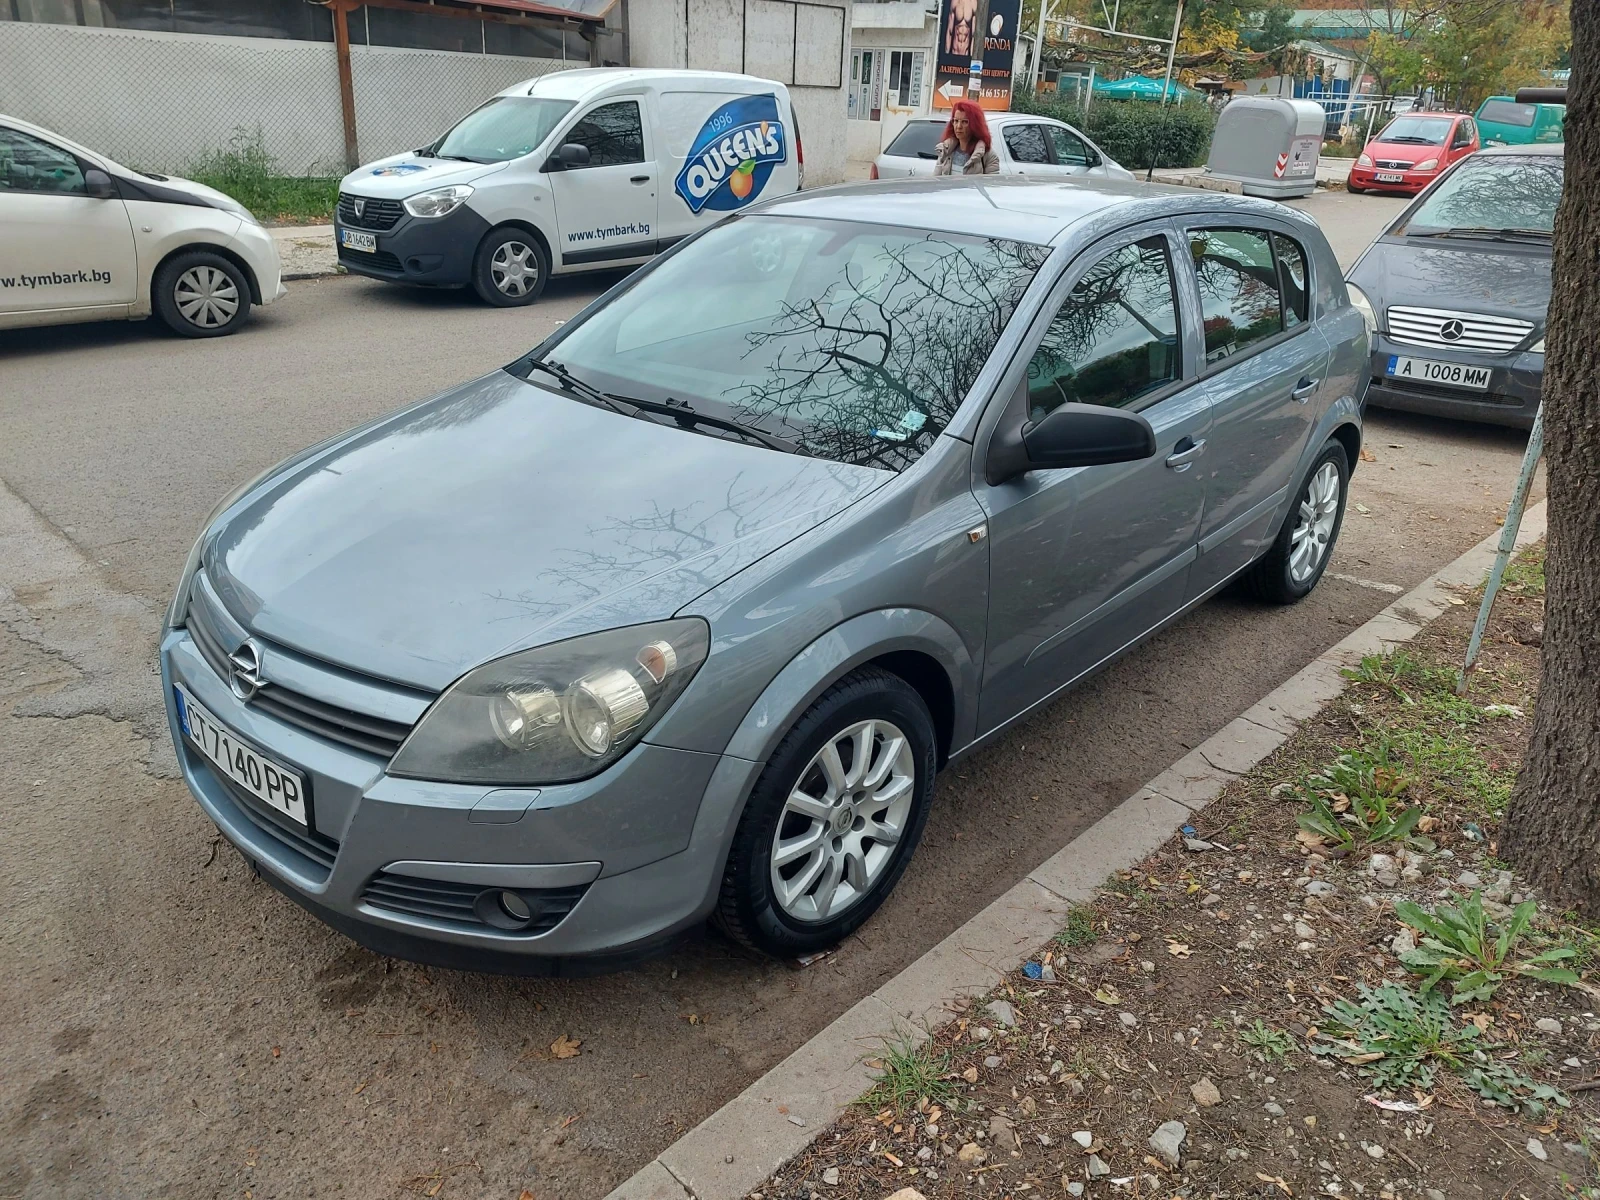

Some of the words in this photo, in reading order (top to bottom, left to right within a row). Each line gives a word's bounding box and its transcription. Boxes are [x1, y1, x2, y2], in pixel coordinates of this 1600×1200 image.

[708, 111, 733, 132] 1996
[567, 222, 650, 242] www.tymbark.bg
[1402, 360, 1412, 375] A
[1424, 363, 1462, 382] 1008
[1463, 368, 1488, 386] MM
[187, 704, 207, 750] CT
[209, 727, 261, 791] 7140
[263, 764, 298, 810] PP
